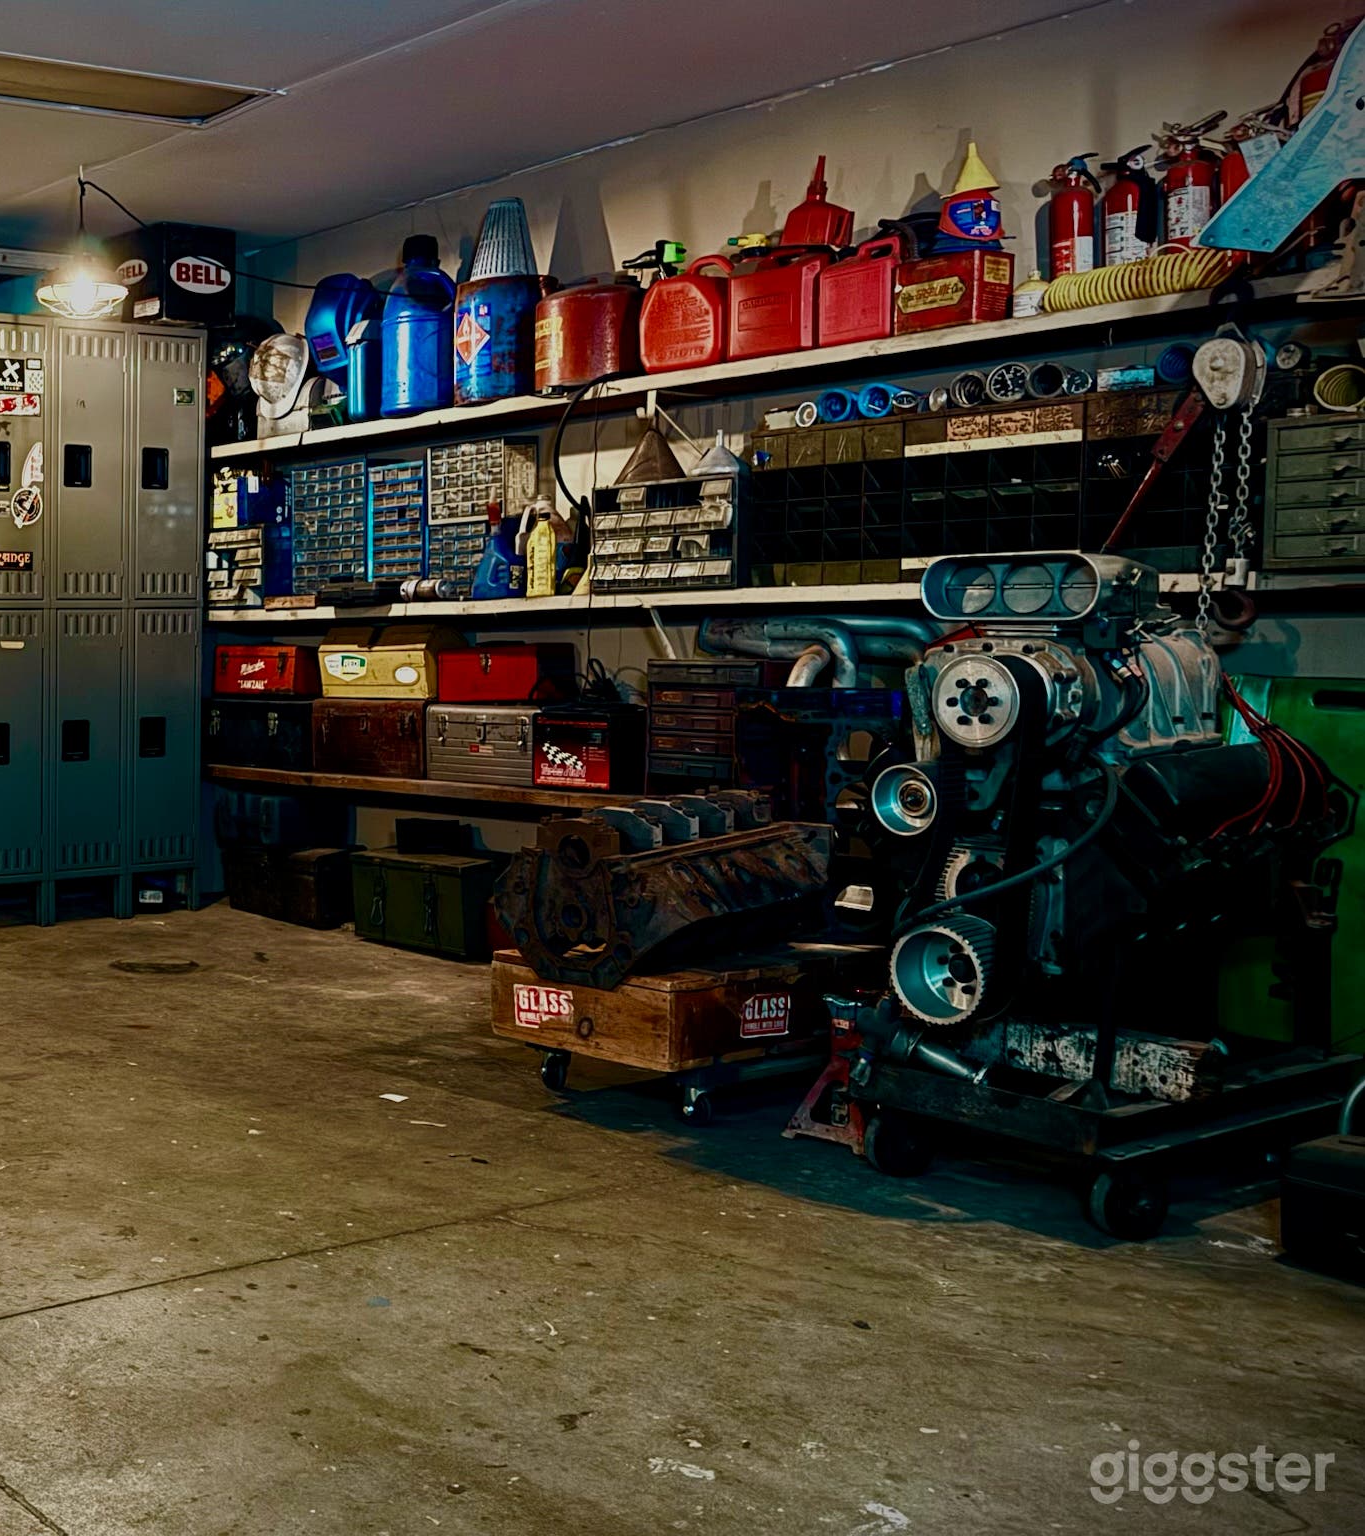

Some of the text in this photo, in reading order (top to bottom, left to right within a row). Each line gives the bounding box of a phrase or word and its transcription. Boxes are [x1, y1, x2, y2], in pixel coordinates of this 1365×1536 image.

[176, 262, 227, 287] BELL
[518, 989, 570, 1015] GLASS
[745, 996, 786, 1020] GLASS
